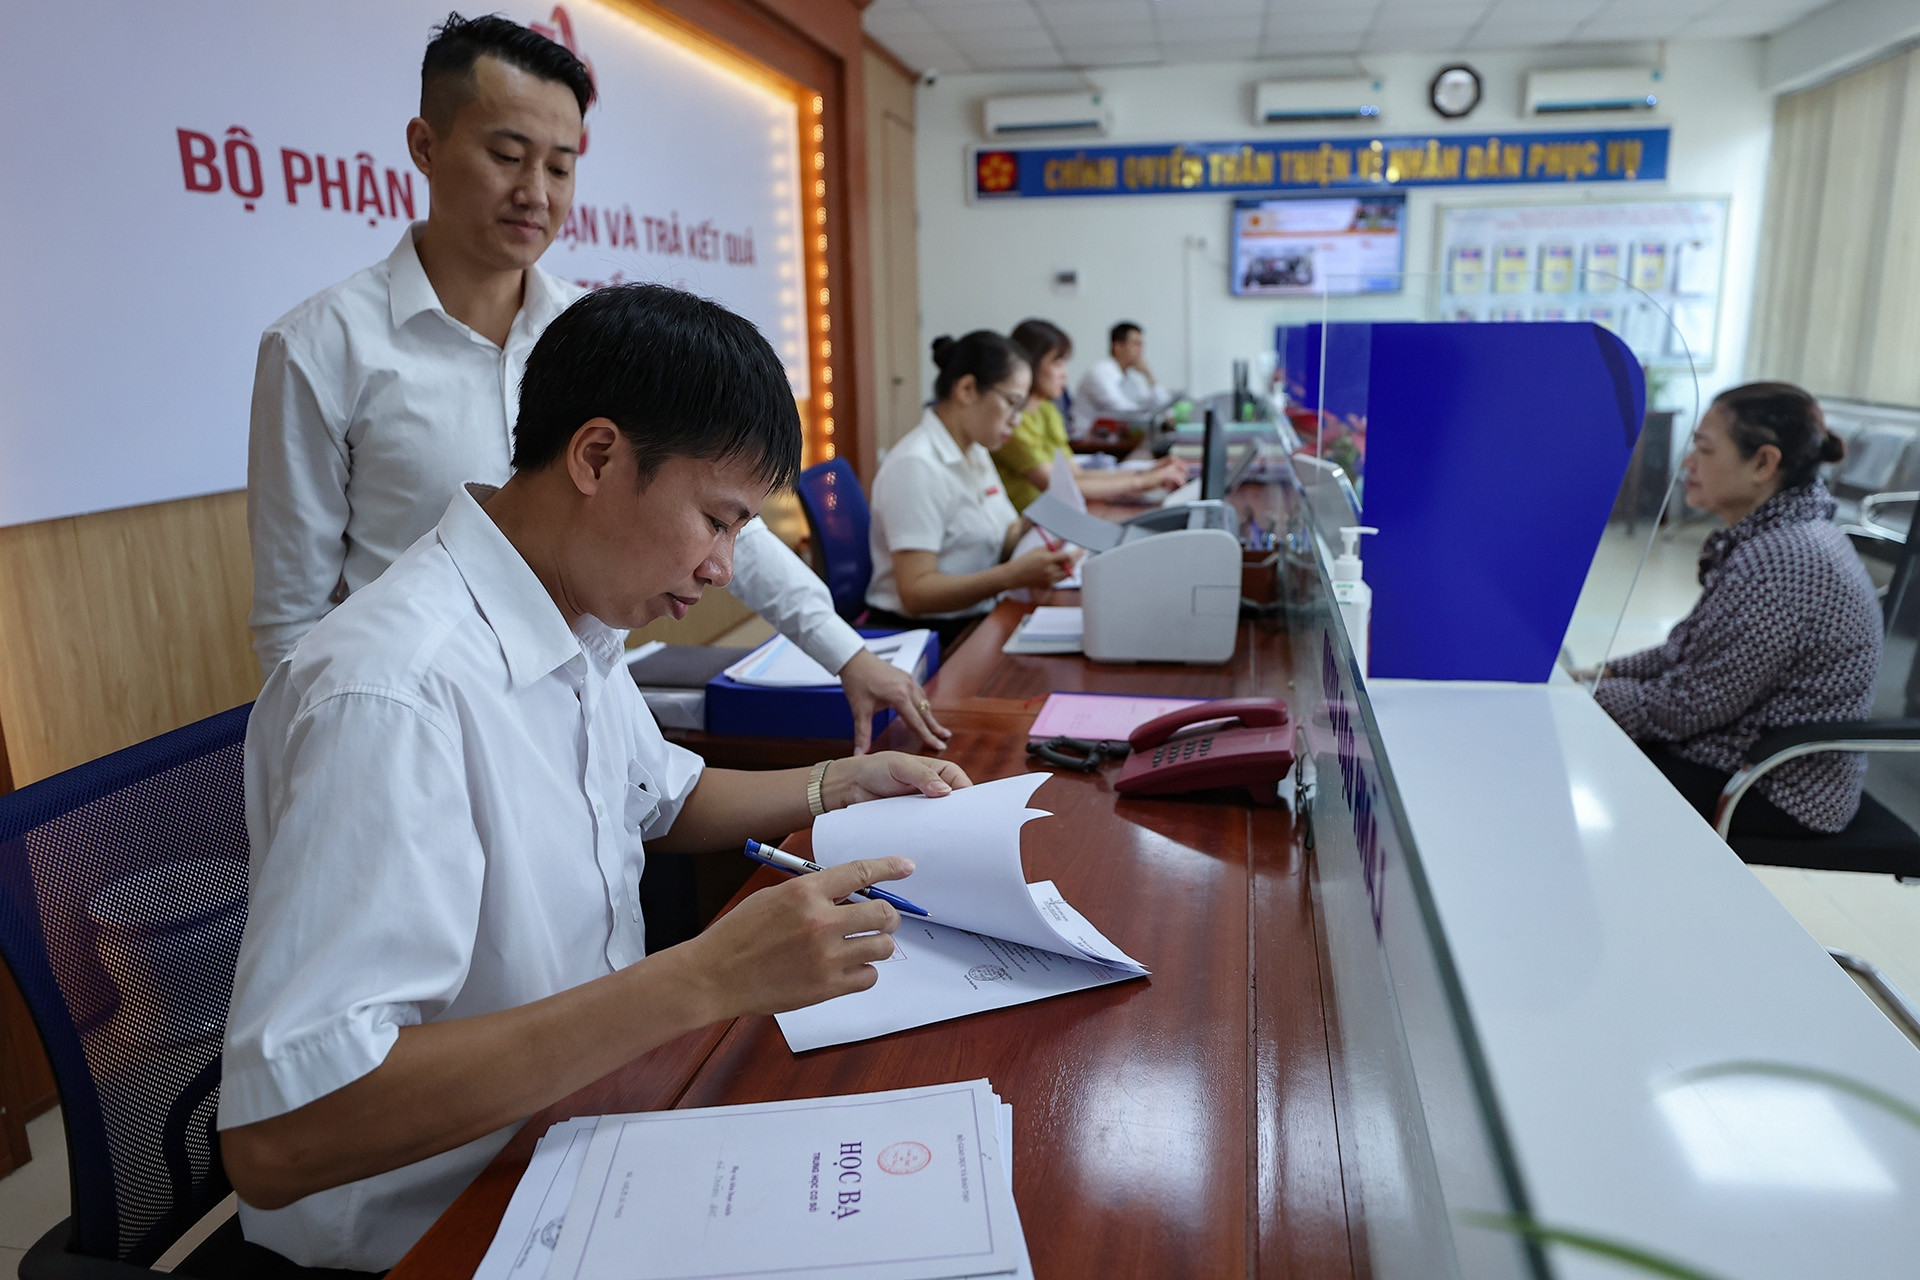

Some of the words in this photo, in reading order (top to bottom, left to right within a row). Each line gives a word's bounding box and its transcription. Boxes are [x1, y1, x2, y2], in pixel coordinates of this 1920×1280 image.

[176, 125, 264, 213] BỘ
[280, 147, 416, 227] PHẬN
[604, 204, 639, 249] VÀ
[643, 210, 683, 255] TRẢ
[687, 219, 720, 261] KẾT
[811, 1152, 821, 1173] TRUNG
[833, 1141, 862, 1184] HỌC
[809, 1174, 819, 1189] HỌC
[830, 1190, 862, 1220] BẠ
